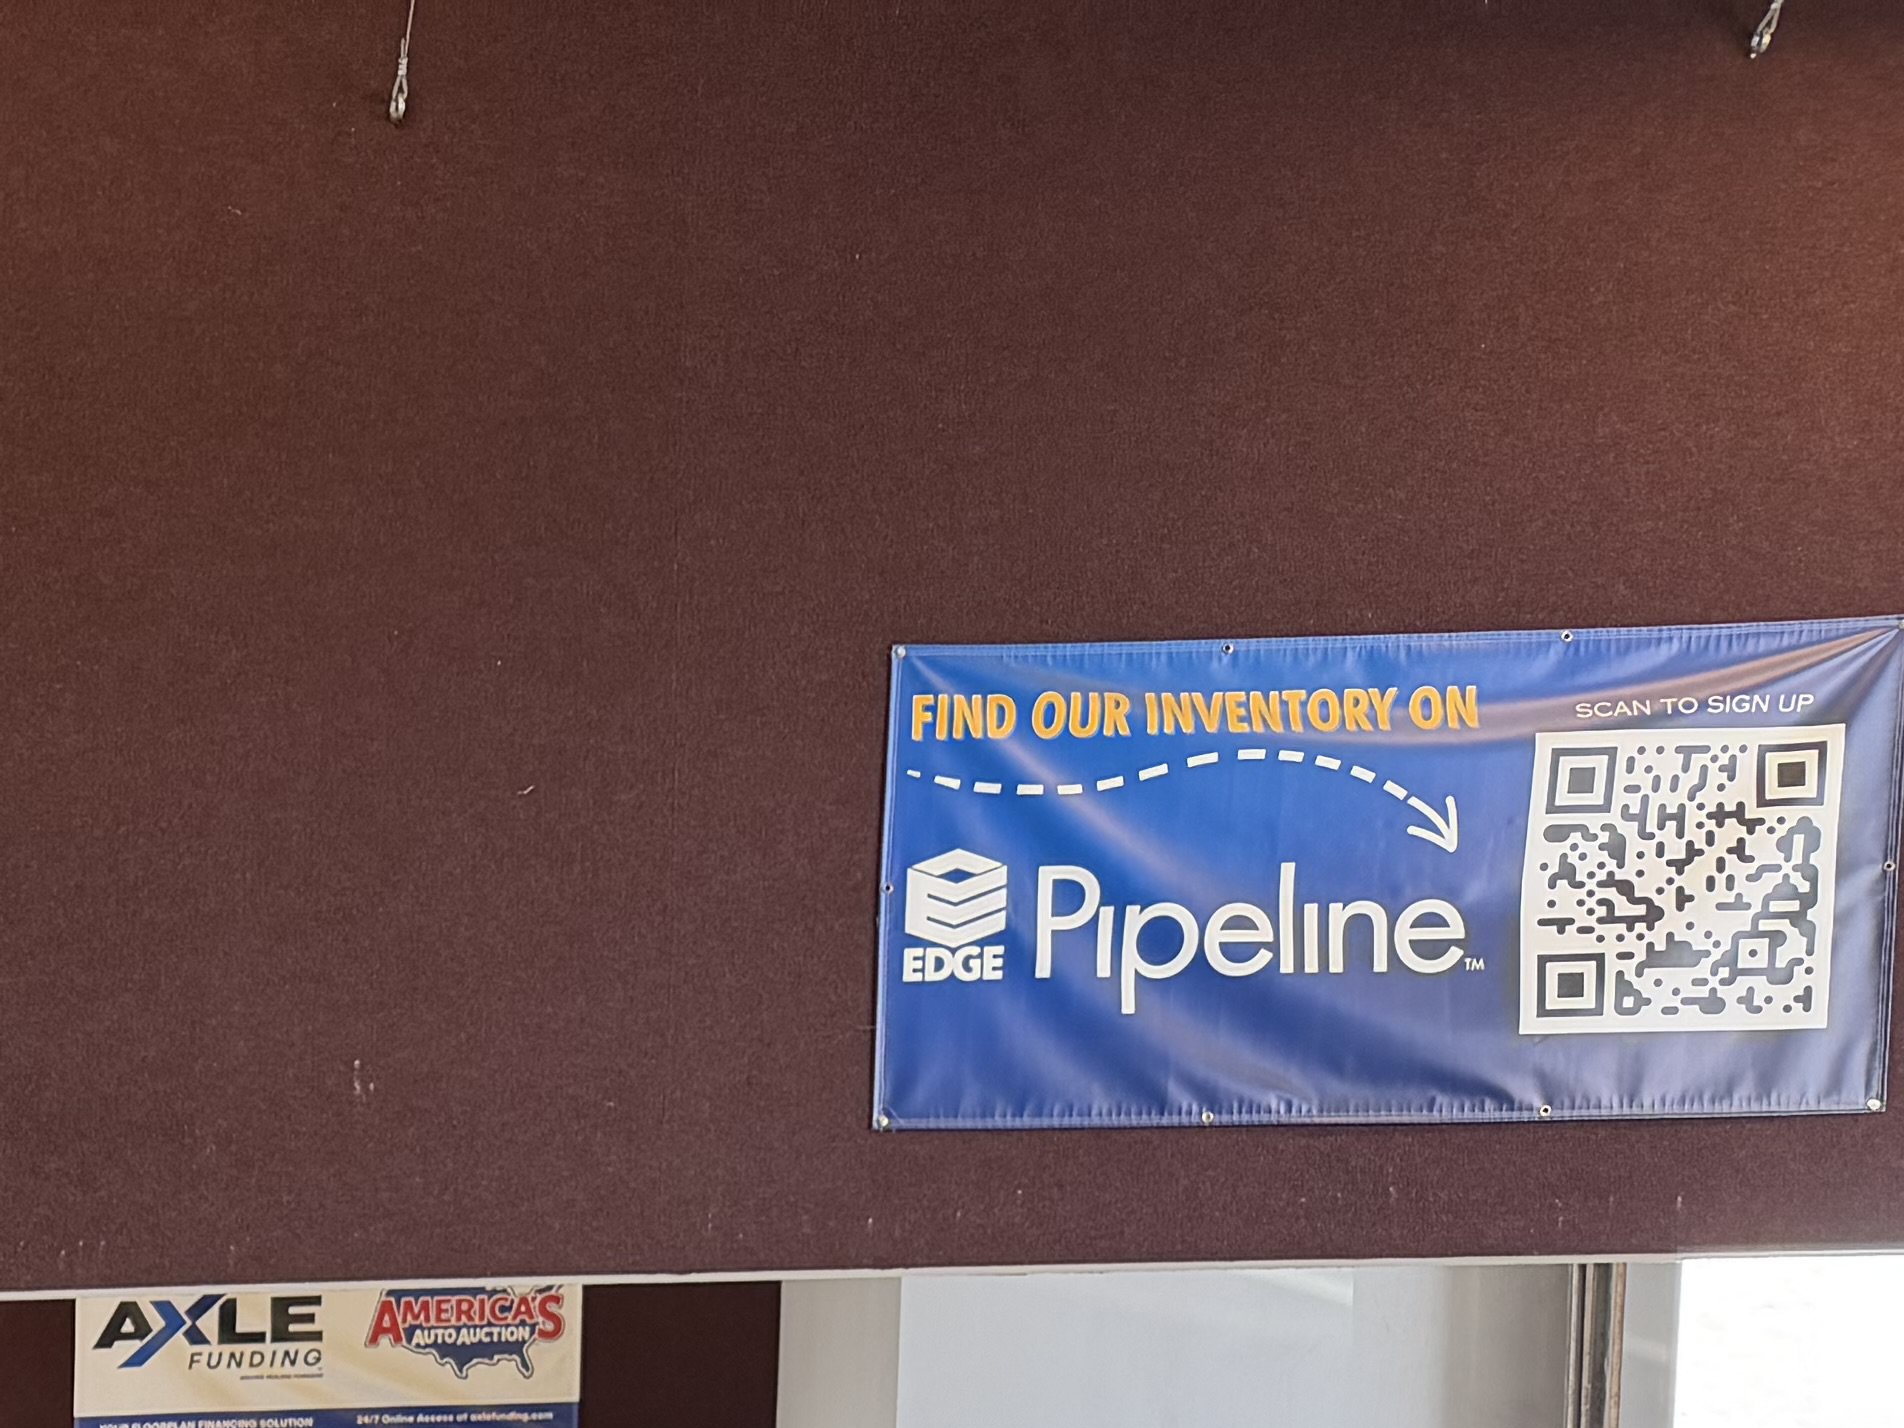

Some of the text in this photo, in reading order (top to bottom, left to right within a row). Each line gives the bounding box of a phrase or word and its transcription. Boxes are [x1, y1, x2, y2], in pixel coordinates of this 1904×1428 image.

[911, 685, 1480, 742] FIND OUR INVENTORY ON
[1575, 693, 1814, 719] SCAN TO SIGN UP
[902, 945, 1005, 983] EDGE
[92, 1293, 323, 1369] AXLE
[364, 1293, 568, 1348] AMERICA'S
[410, 1325, 531, 1347] AUTO AUCTION
[188, 1348, 323, 1371] FUNDING
[259, 1417, 314, 1428] SOLUTION
